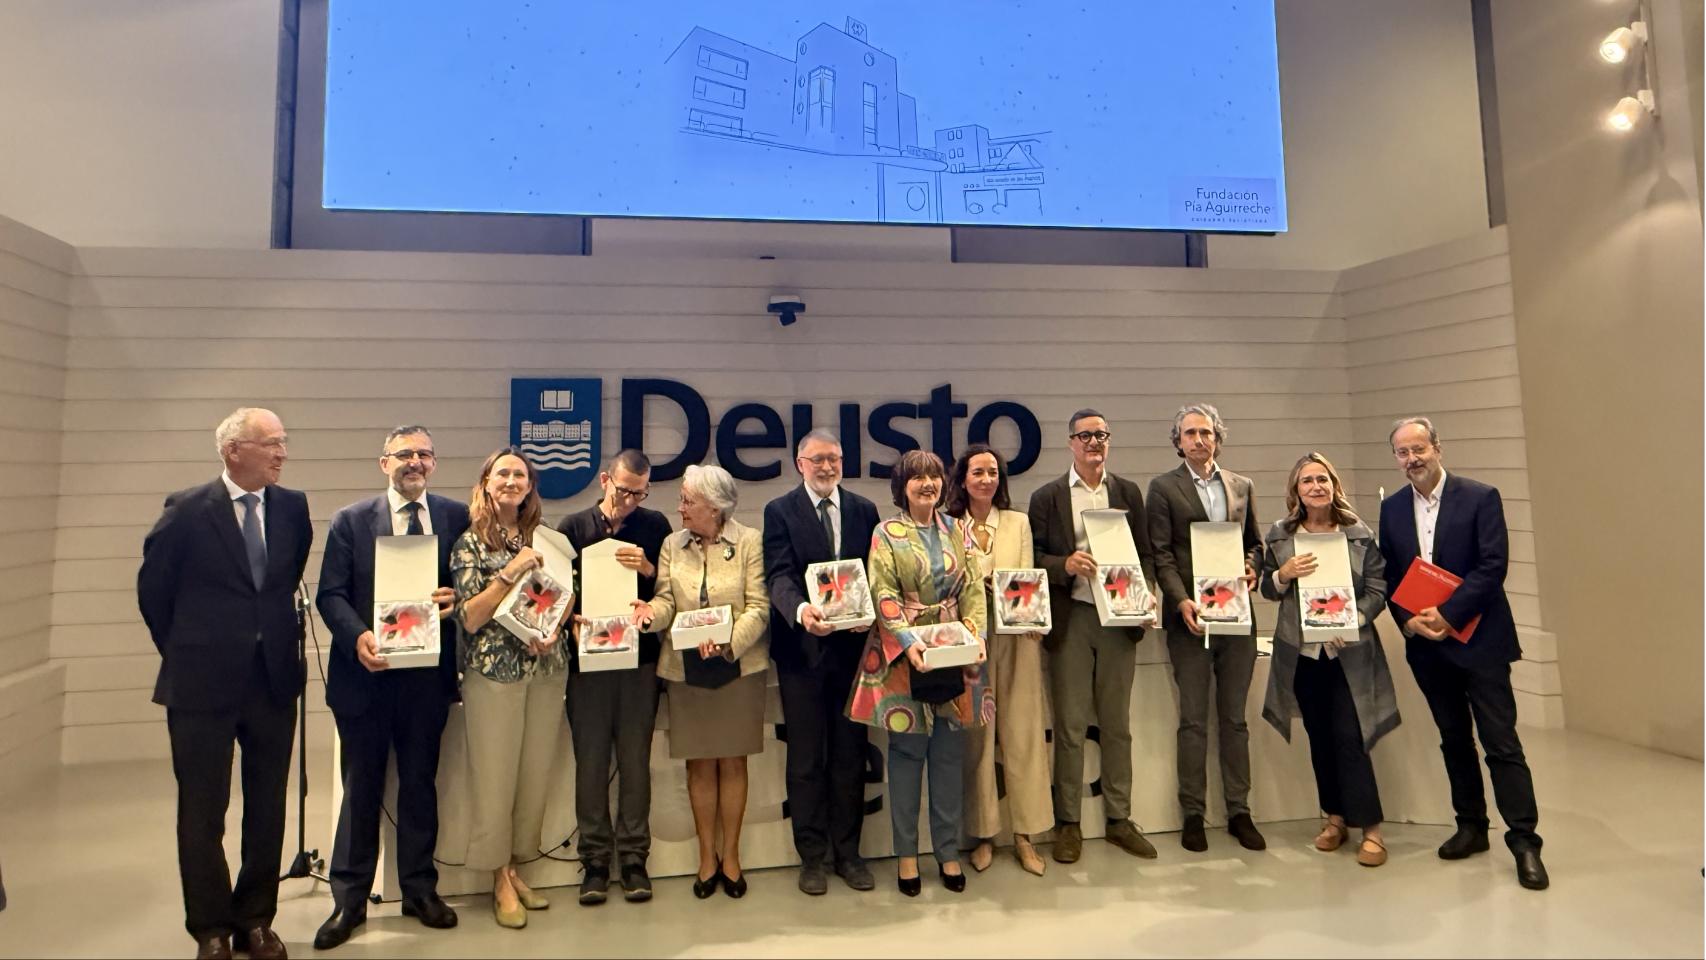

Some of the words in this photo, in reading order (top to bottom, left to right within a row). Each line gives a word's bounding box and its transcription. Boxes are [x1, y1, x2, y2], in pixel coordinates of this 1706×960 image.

[1196, 187, 1259, 201] Fundación
[1184, 200, 1202, 213] Pía
[1205, 201, 1271, 216] Aguirreche
[621, 378, 1042, 482] Deusto
